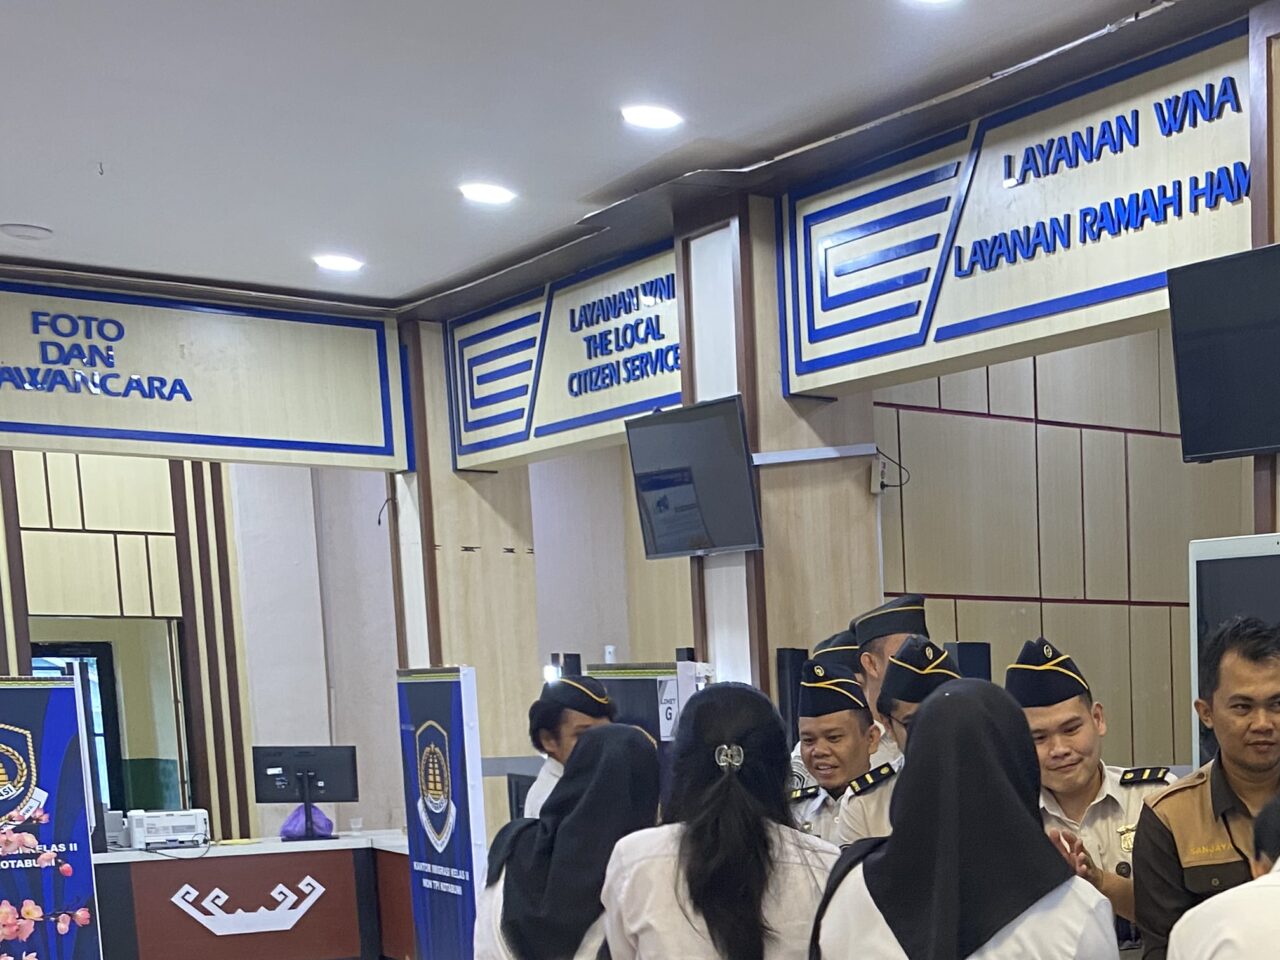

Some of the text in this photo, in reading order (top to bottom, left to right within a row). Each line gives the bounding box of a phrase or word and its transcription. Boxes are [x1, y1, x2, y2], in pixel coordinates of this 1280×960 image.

[1003, 76, 1243, 188] LAYANAN WNA
[954, 213, 1071, 278] LAYANAN
[1079, 180, 1183, 244] RAMAH
[570, 273, 676, 332] LAYANAN WNI
[31, 311, 125, 342] FOTO
[583, 315, 665, 360] THE LOCAL
[40, 341, 115, 368] DAN
[568, 360, 621, 397] CITIZEN
[666, 706, 672, 720] G
